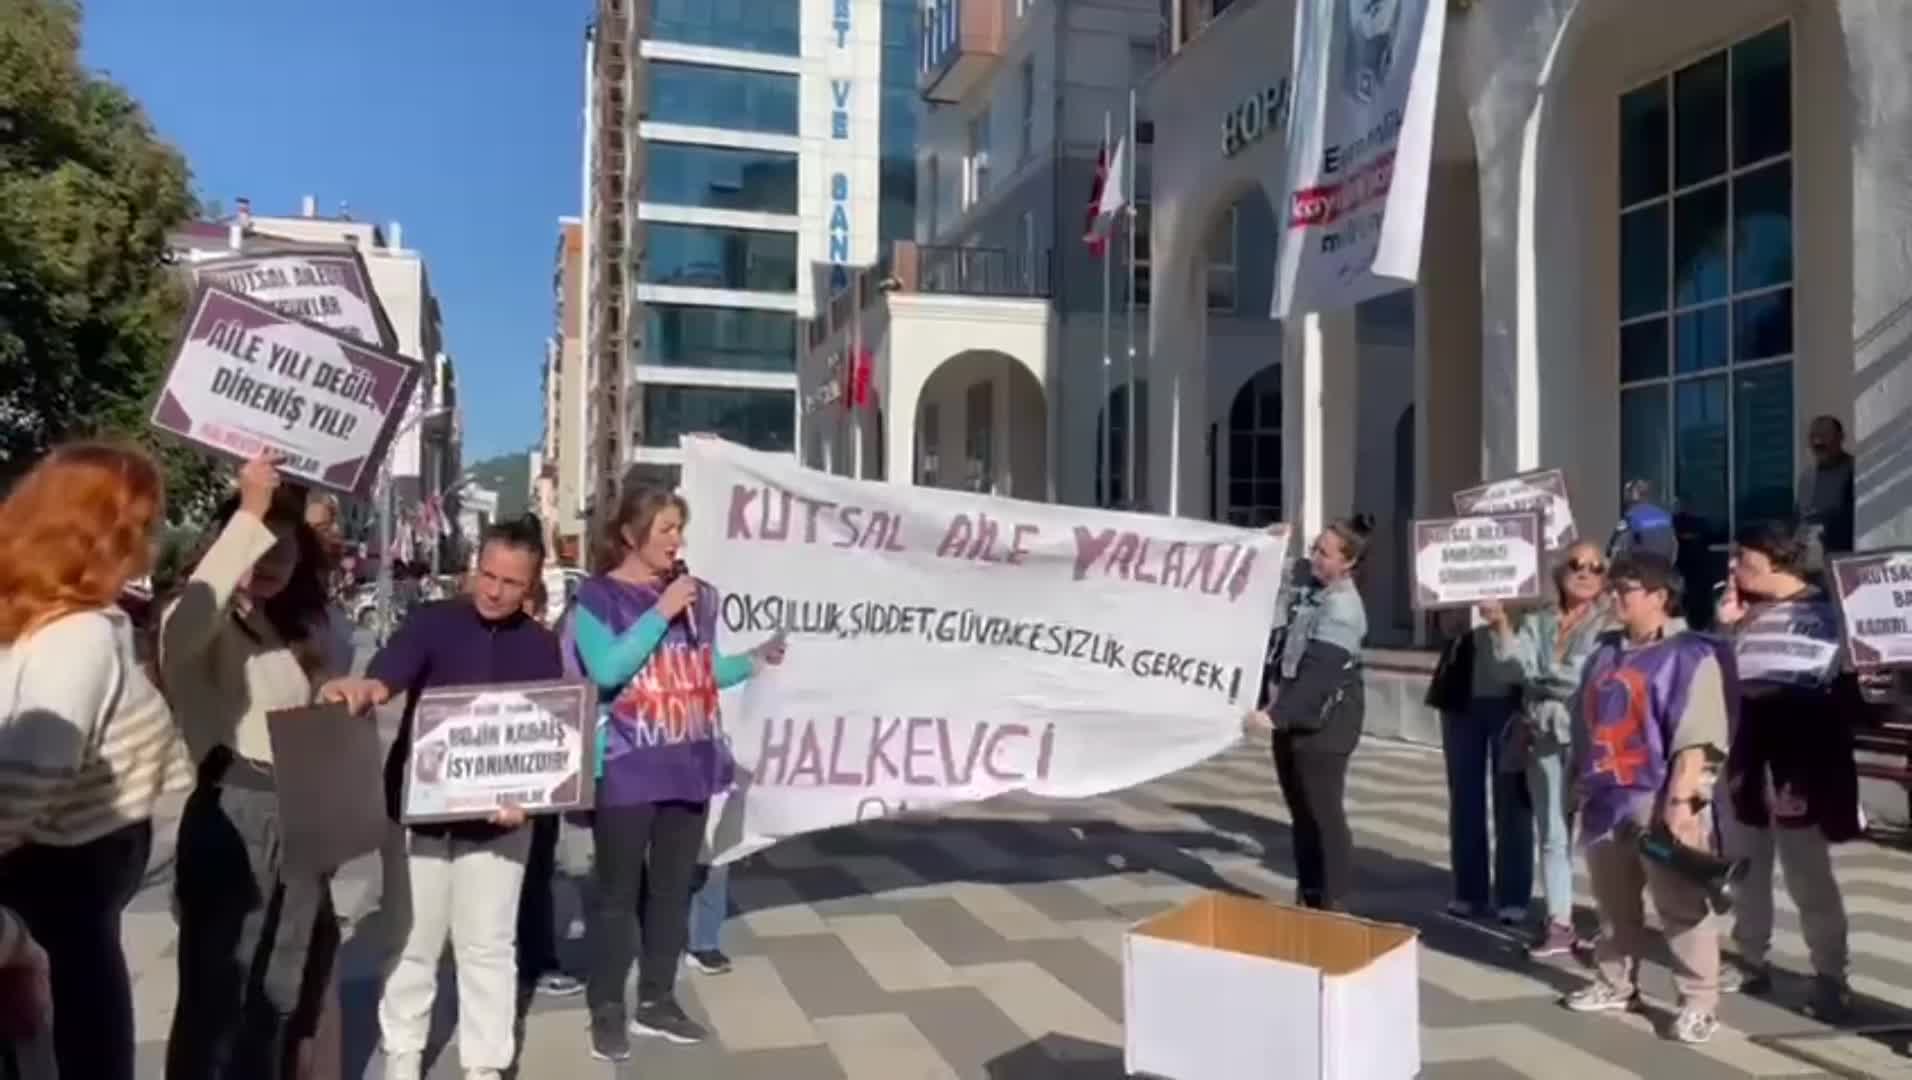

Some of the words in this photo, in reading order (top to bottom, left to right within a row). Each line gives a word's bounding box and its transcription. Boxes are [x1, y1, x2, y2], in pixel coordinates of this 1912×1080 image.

[207, 319, 264, 364] AİLE
[728, 484, 905, 552] KUTSAL
[754, 716, 1055, 786] HALKEVCİ
